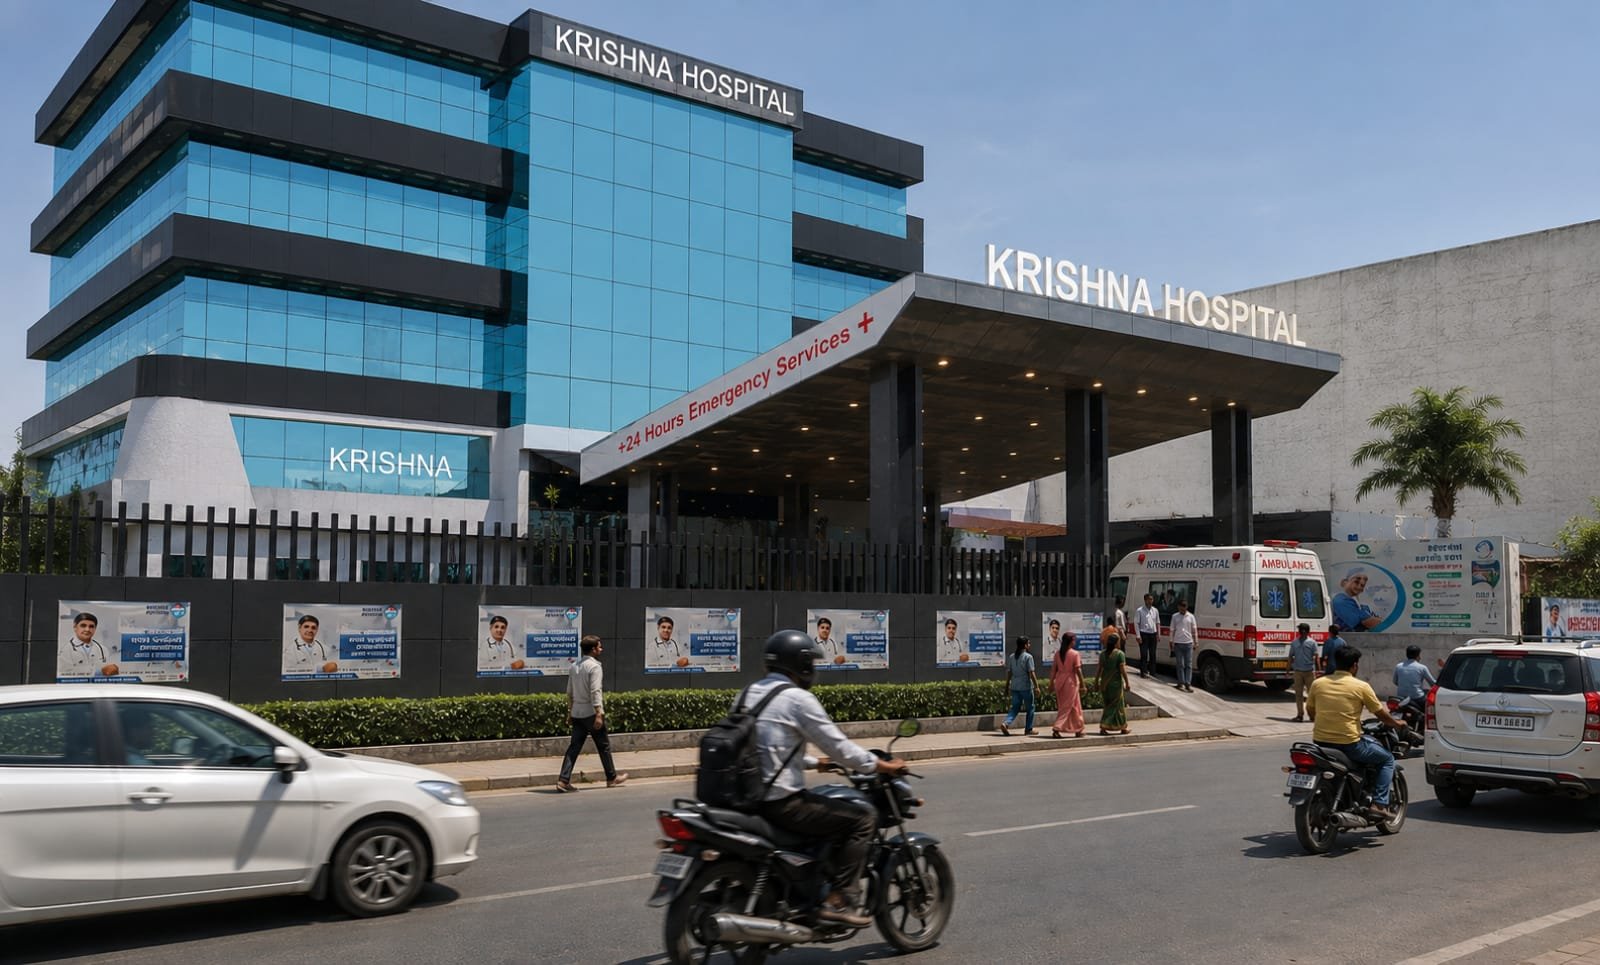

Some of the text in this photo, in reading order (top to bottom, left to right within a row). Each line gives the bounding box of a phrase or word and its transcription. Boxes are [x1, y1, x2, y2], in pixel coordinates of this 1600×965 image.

[555, 25, 794, 117] KRISHNA HOSPITAL
[985, 244, 1307, 348] KRISHNA HOSPITAL
[645, 412, 685, 443] Hours
[688, 368, 771, 422] Emergency
[776, 327, 851, 377] Services
[329, 447, 453, 479] KRISHNA
[1146, 559, 1230, 569] KRISHNA HOSPITAL
[1261, 559, 1315, 570] AMBULANCE
